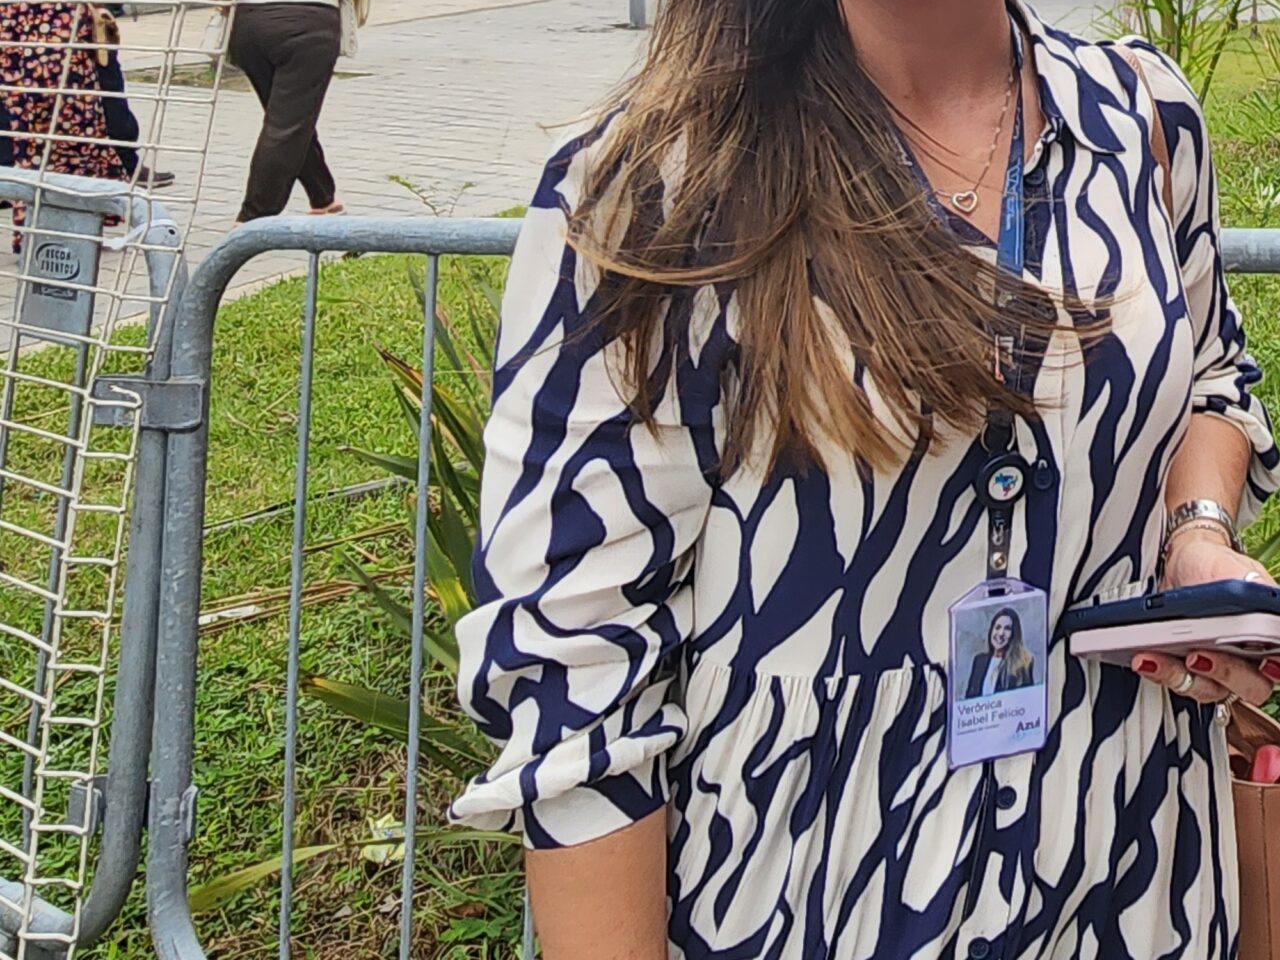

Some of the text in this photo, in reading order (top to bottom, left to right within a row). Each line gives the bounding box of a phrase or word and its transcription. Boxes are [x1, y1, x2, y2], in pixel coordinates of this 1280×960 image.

[957, 700, 1002, 715] Verônica
[957, 713, 988, 729] Isabel
[1015, 716, 1041, 733] Azul
